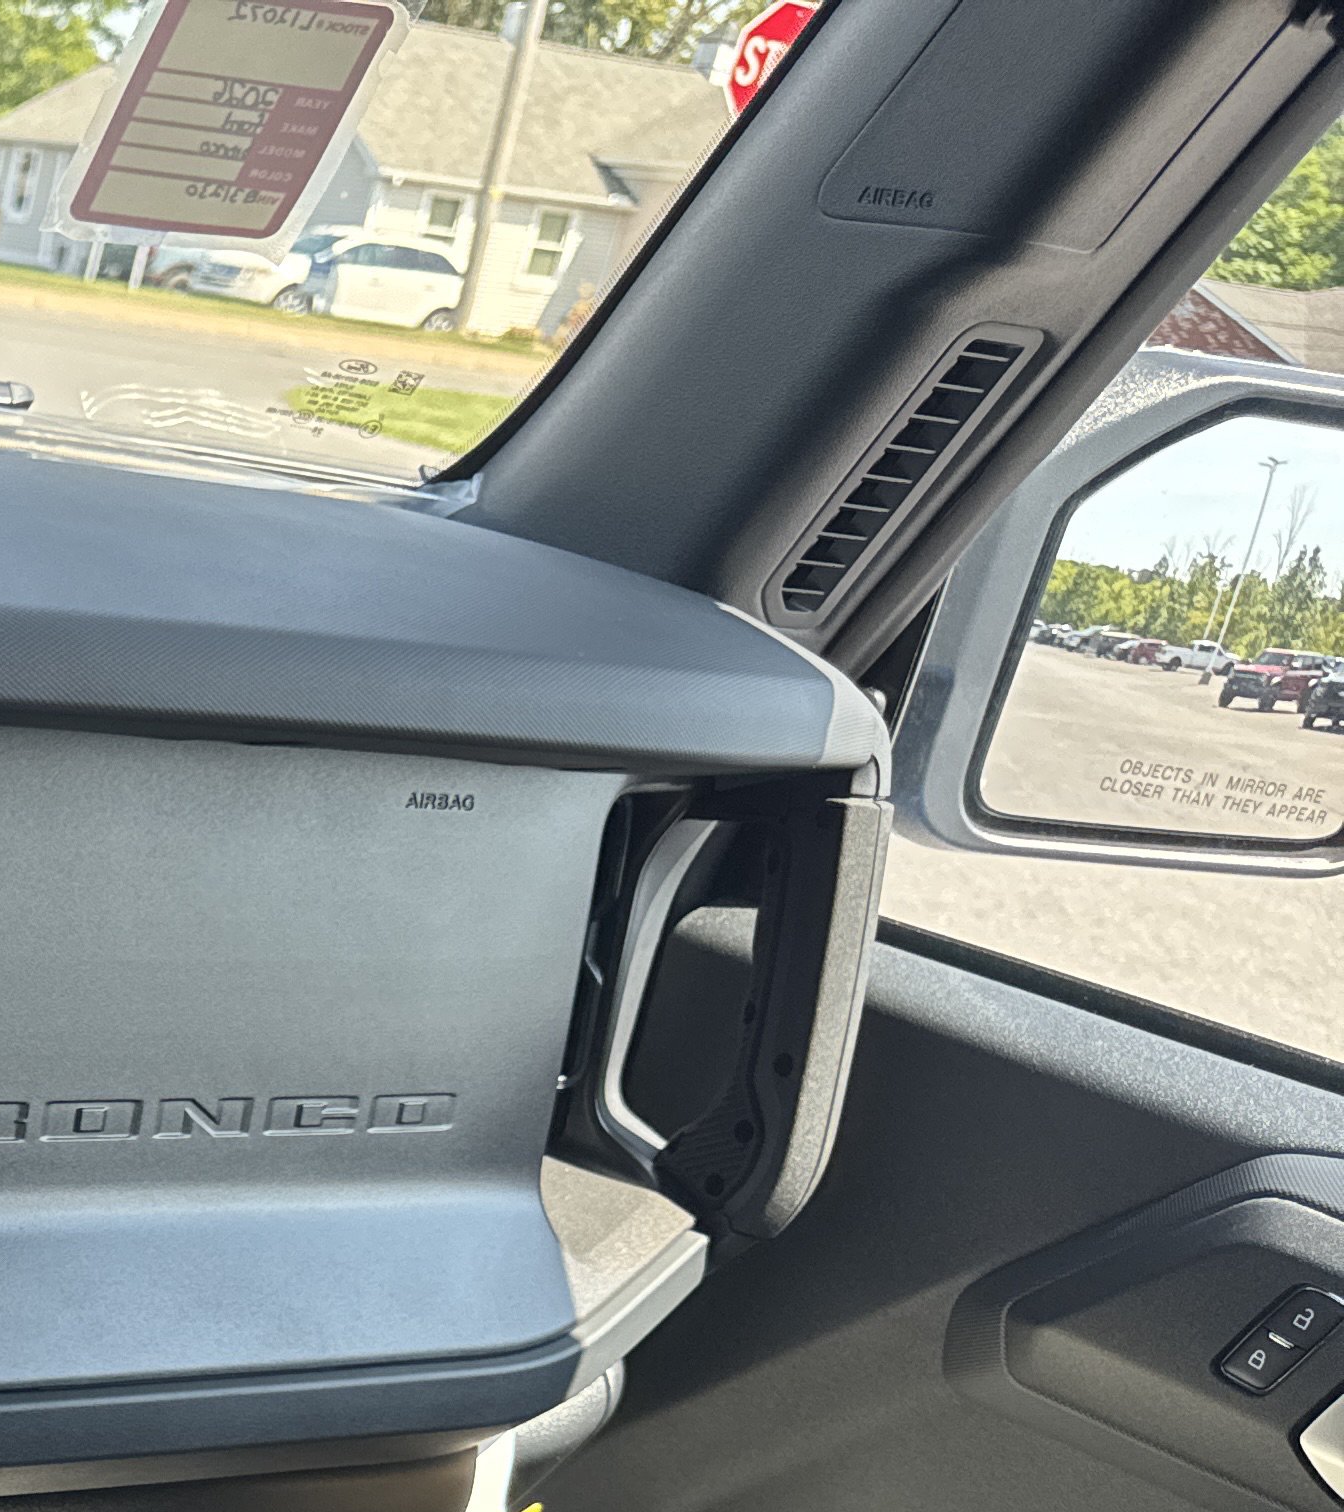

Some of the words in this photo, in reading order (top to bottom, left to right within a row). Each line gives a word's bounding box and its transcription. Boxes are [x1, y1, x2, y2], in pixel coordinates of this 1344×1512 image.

[857, 186, 937, 210] AIRBAG
[1119, 758, 1194, 783] OBJECTS
[1200, 772, 1219, 788] IN
[1225, 775, 1288, 798] MIRROR
[1292, 785, 1327, 804] ARE
[405, 791, 476, 812] AIRBAG
[1099, 776, 1163, 799] CLOSER
[1173, 787, 1215, 808] THAN
[1221, 795, 1263, 814] THEY
[1265, 803, 1328, 825] APPEAR
